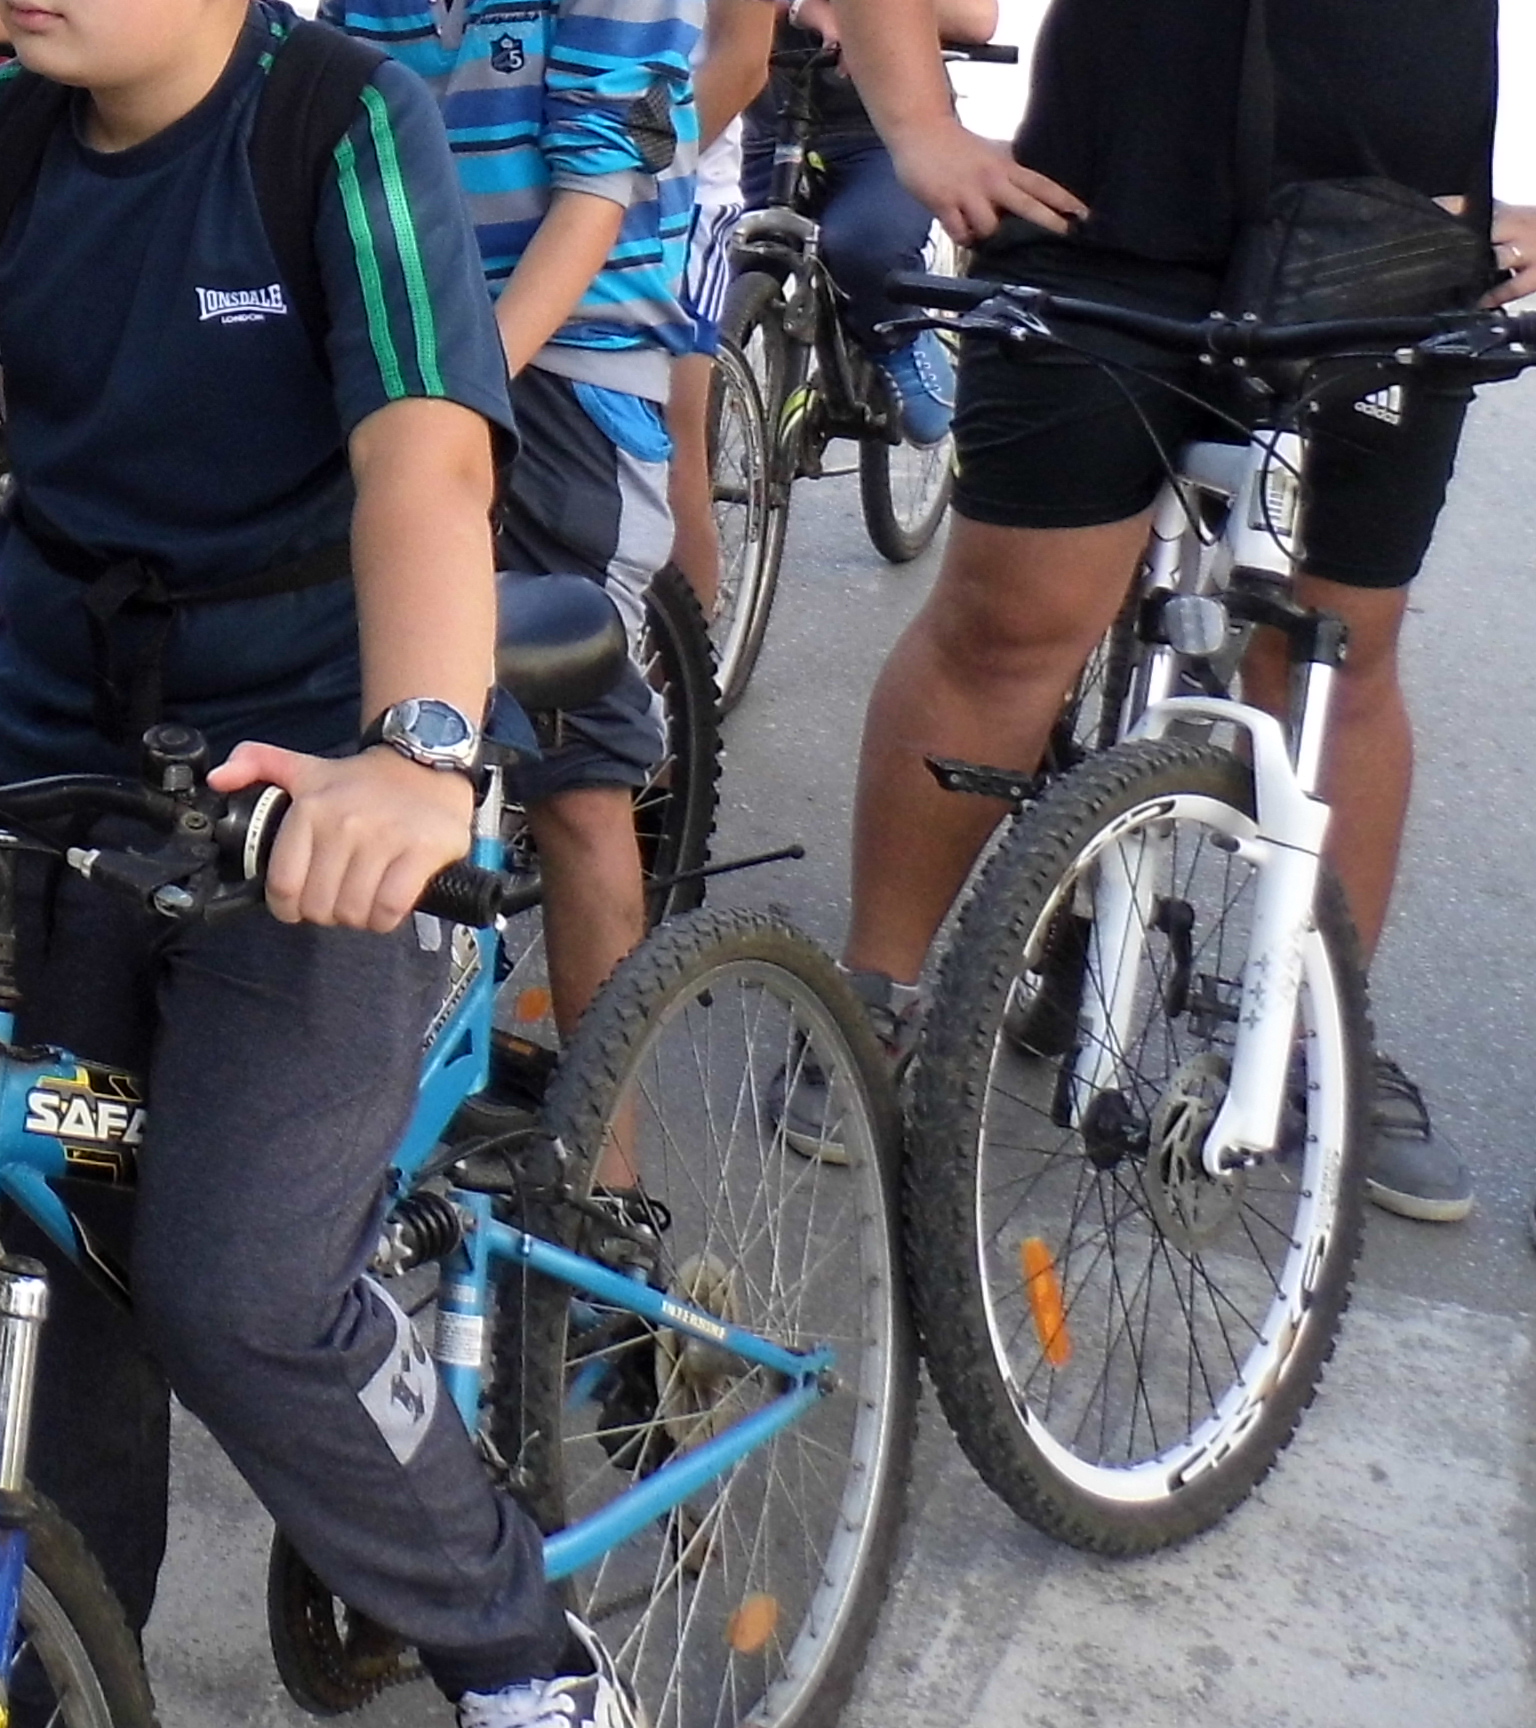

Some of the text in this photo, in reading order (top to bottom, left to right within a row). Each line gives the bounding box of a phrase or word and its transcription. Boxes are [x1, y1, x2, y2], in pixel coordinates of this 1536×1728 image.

[509, 49, 523, 69] 5
[195, 283, 288, 321] LONSDALE
[1353, 401, 1401, 426] adidas
